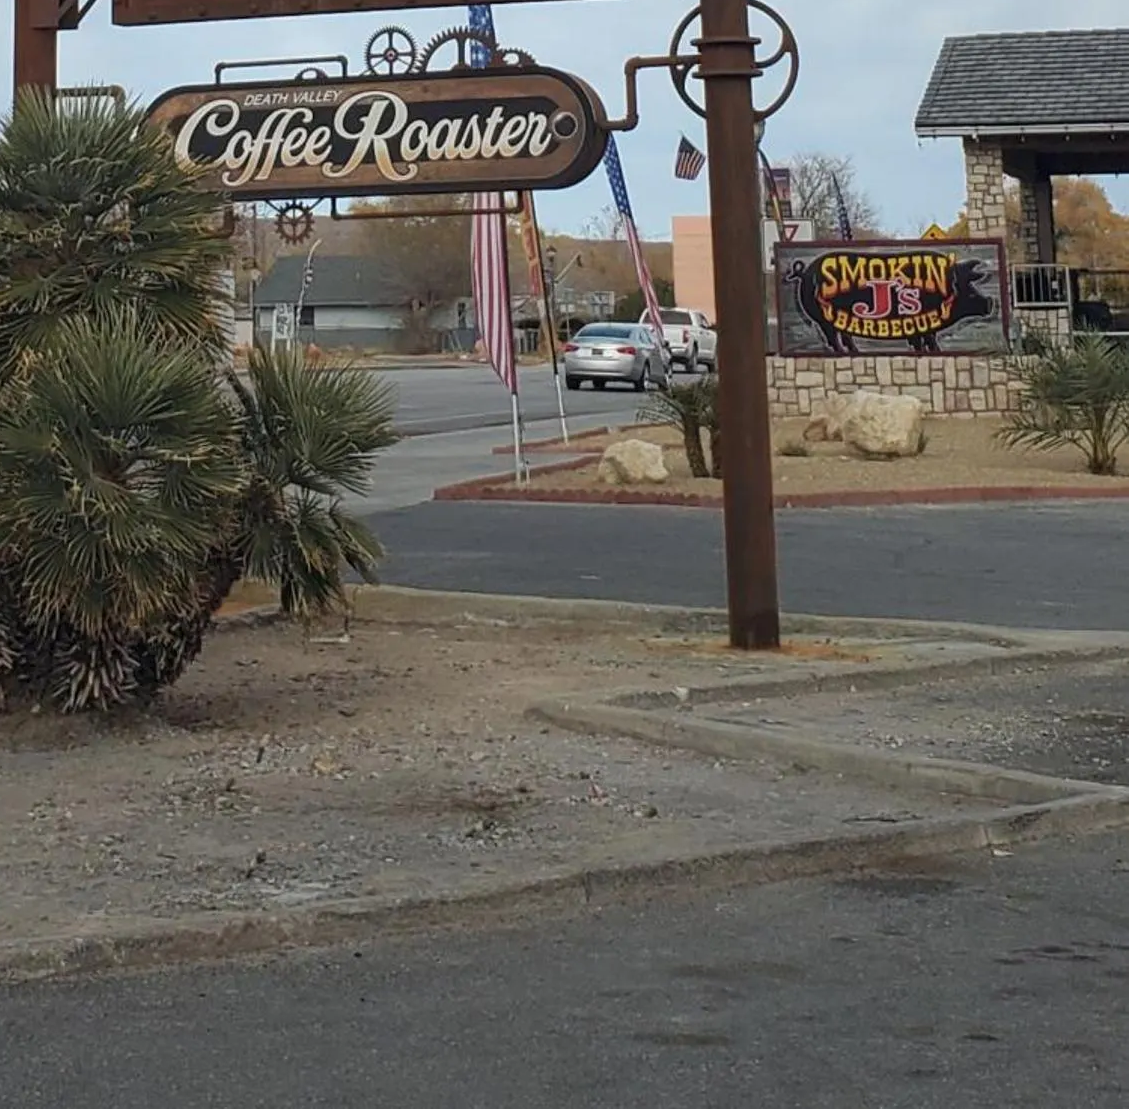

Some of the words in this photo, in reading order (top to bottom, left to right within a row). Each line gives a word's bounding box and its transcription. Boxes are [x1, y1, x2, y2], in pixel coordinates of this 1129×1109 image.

[243, 92, 288, 107] DEATH
[293, 90, 343, 104] VALLEY
[175, 99, 333, 186] Coffee
[322, 90, 555, 183] Roaster
[821, 253, 955, 295] SMOKIN'
[833, 310, 942, 337] BARBECUE
